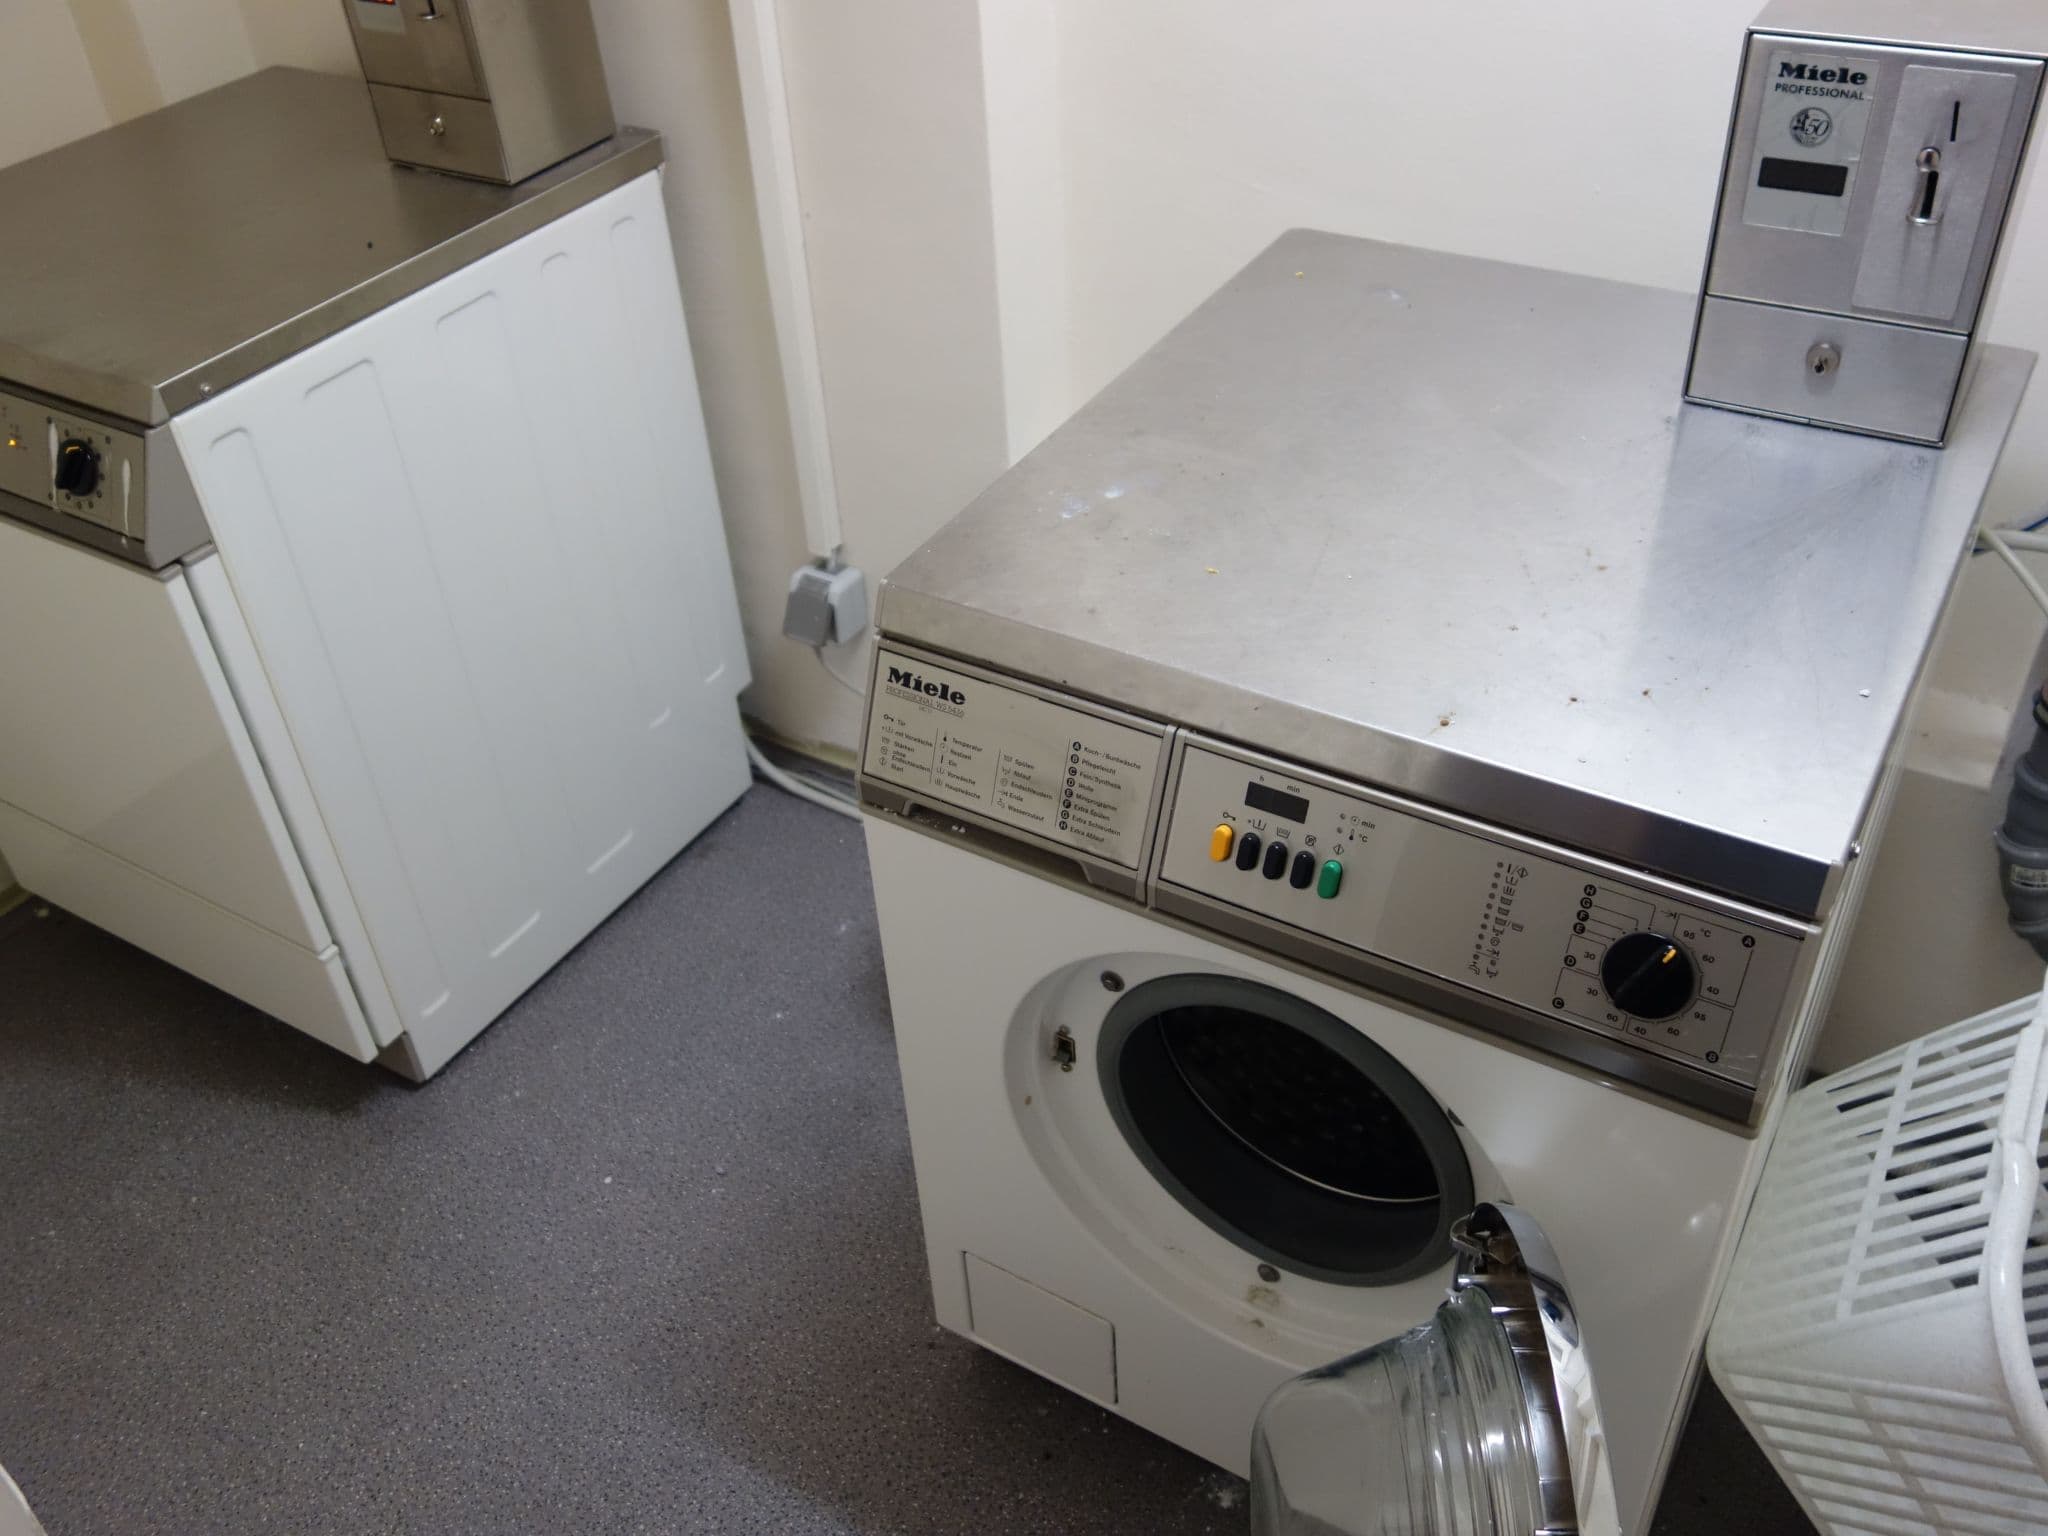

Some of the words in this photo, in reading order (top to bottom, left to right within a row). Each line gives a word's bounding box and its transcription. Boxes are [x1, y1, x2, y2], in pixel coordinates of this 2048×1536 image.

[1778, 62, 1868, 86] Miele
[1775, 82, 1865, 101] PROFESSIONAL
[887, 666, 966, 706] Miele
[952, 737, 984, 752] Temperatur
[1286, 784, 1301, 794] min
[1361, 820, 1376, 830] min
[1683, 930, 1696, 940] 95
[1584, 951, 1596, 960] 30
[1702, 954, 1715, 964] 60
[1586, 987, 1598, 997] 30
[1706, 985, 1720, 995] 40
[1606, 1013, 1619, 1022] 60
[1694, 1011, 1707, 1021] 95
[1634, 1026, 1647, 1036] 40
[1667, 1026, 1680, 1036] 60
